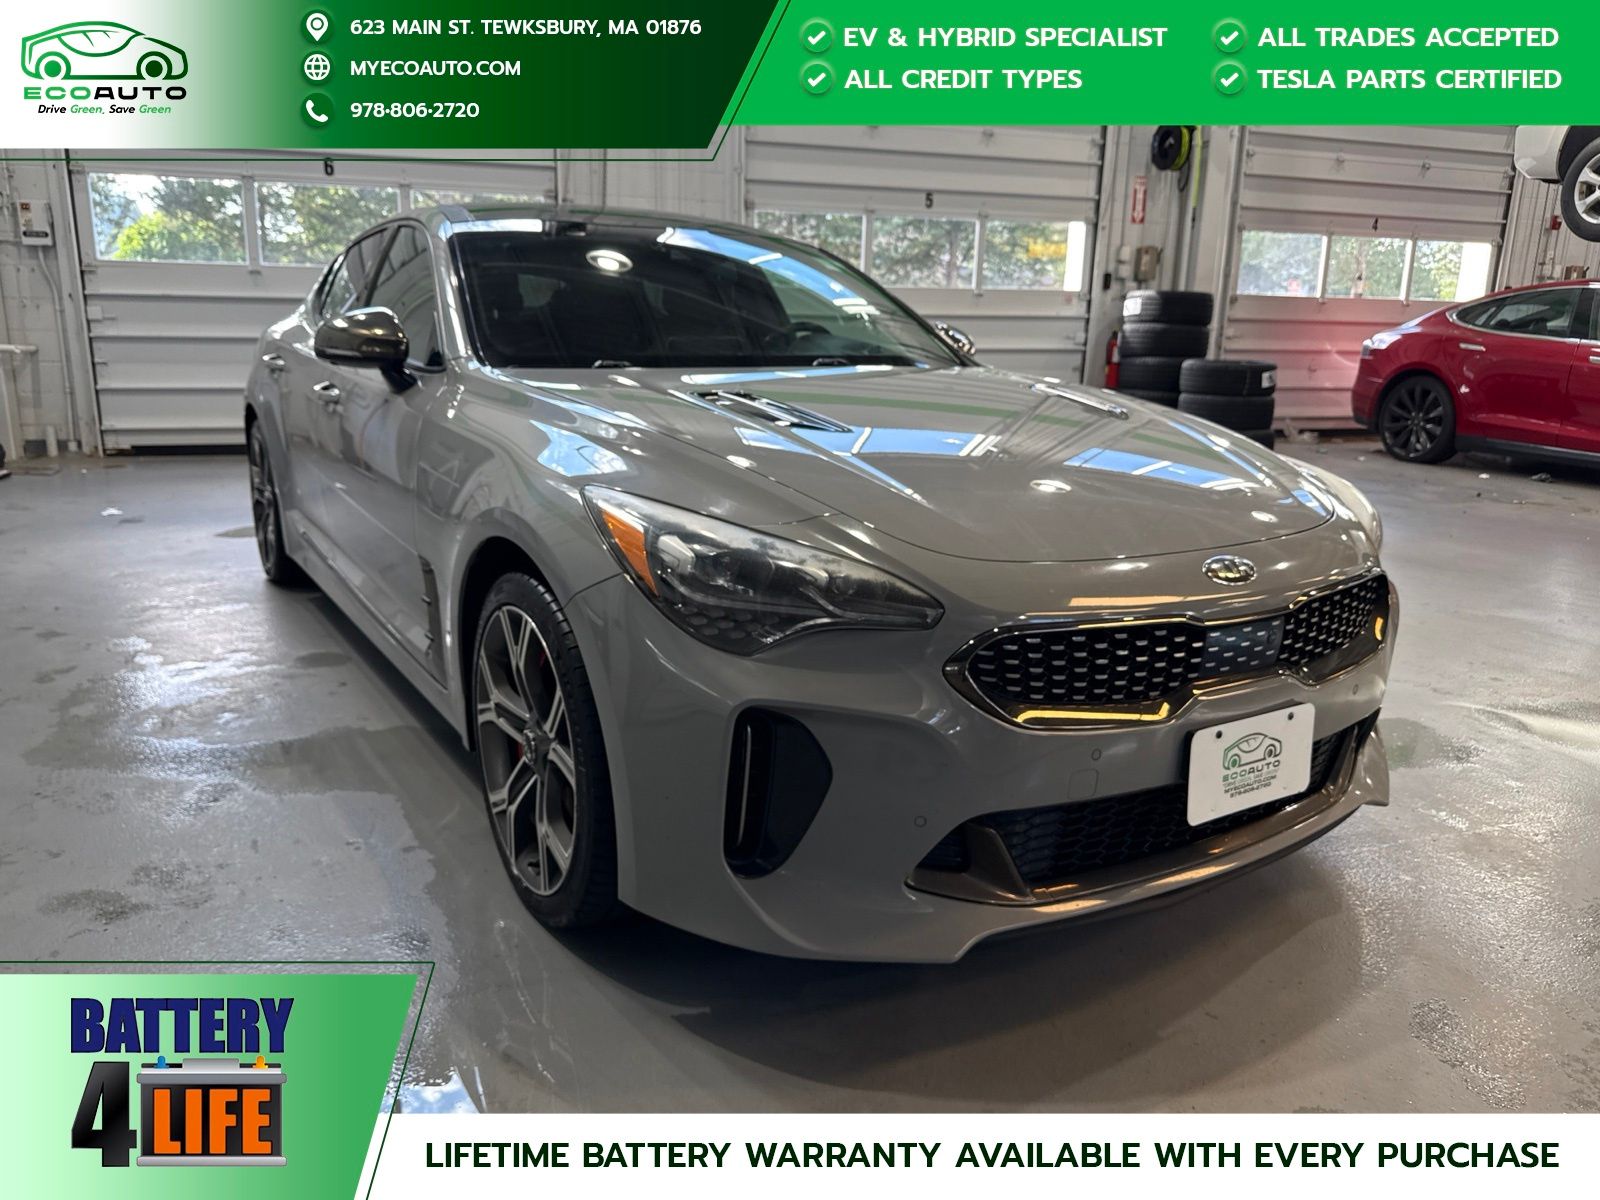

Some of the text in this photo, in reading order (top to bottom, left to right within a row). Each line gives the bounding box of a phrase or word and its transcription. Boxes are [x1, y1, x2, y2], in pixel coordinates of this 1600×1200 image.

[324, 156, 335, 176] 6
[924, 191, 934, 209] 5
[1371, 217, 1379, 231] 4
[1222, 759, 1281, 782] ECOAUTO
